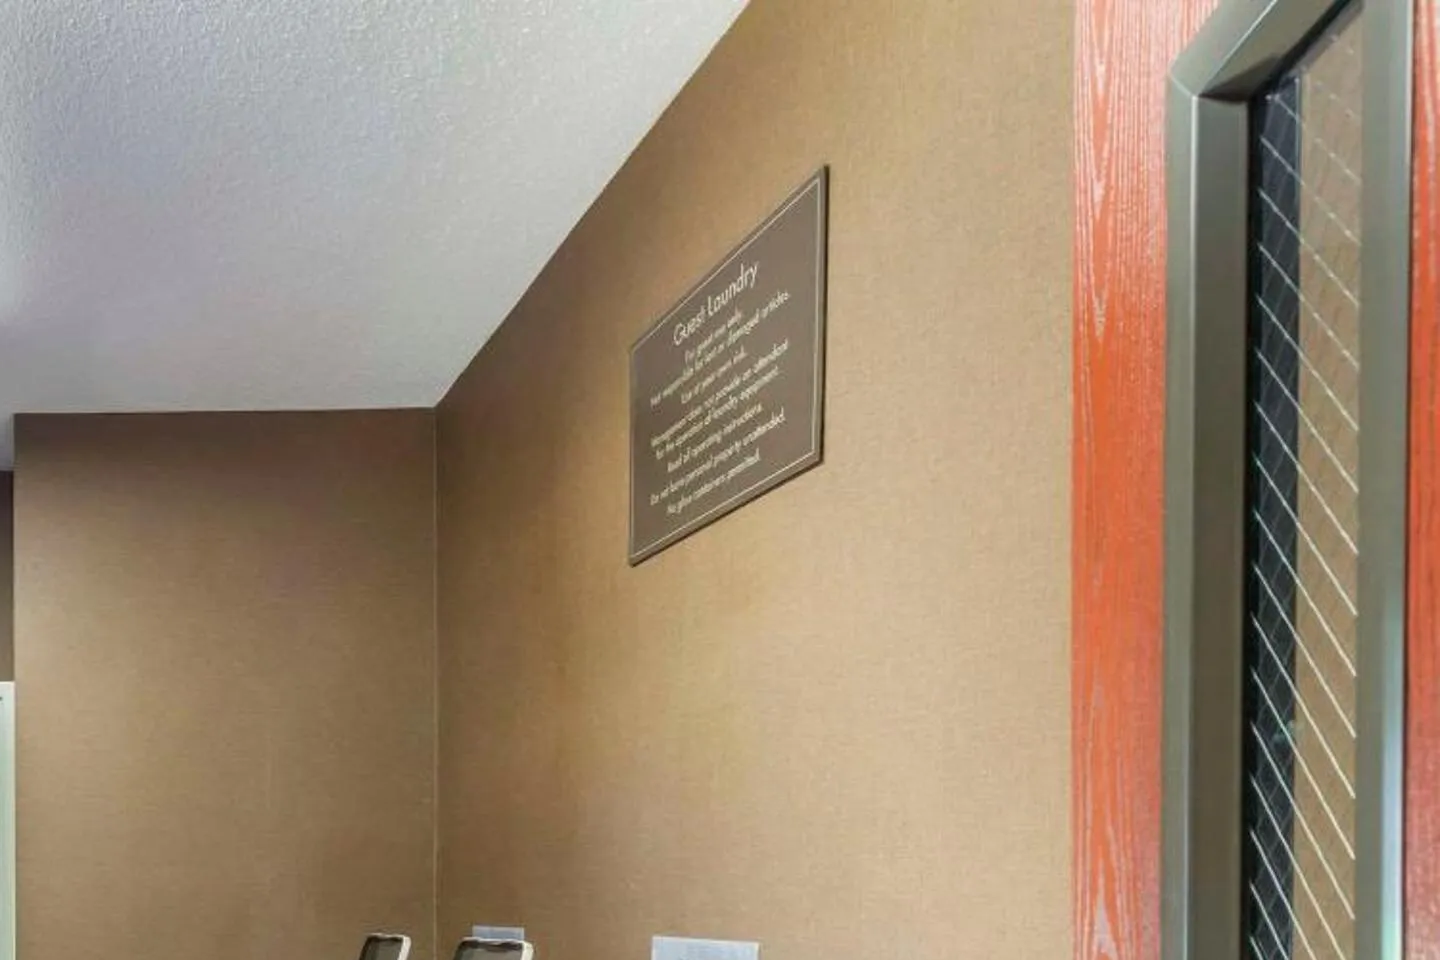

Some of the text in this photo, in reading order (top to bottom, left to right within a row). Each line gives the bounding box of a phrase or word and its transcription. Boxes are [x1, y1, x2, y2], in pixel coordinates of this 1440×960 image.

[673, 263, 758, 346] Guest Laundry
[727, 309, 760, 346] damaged
